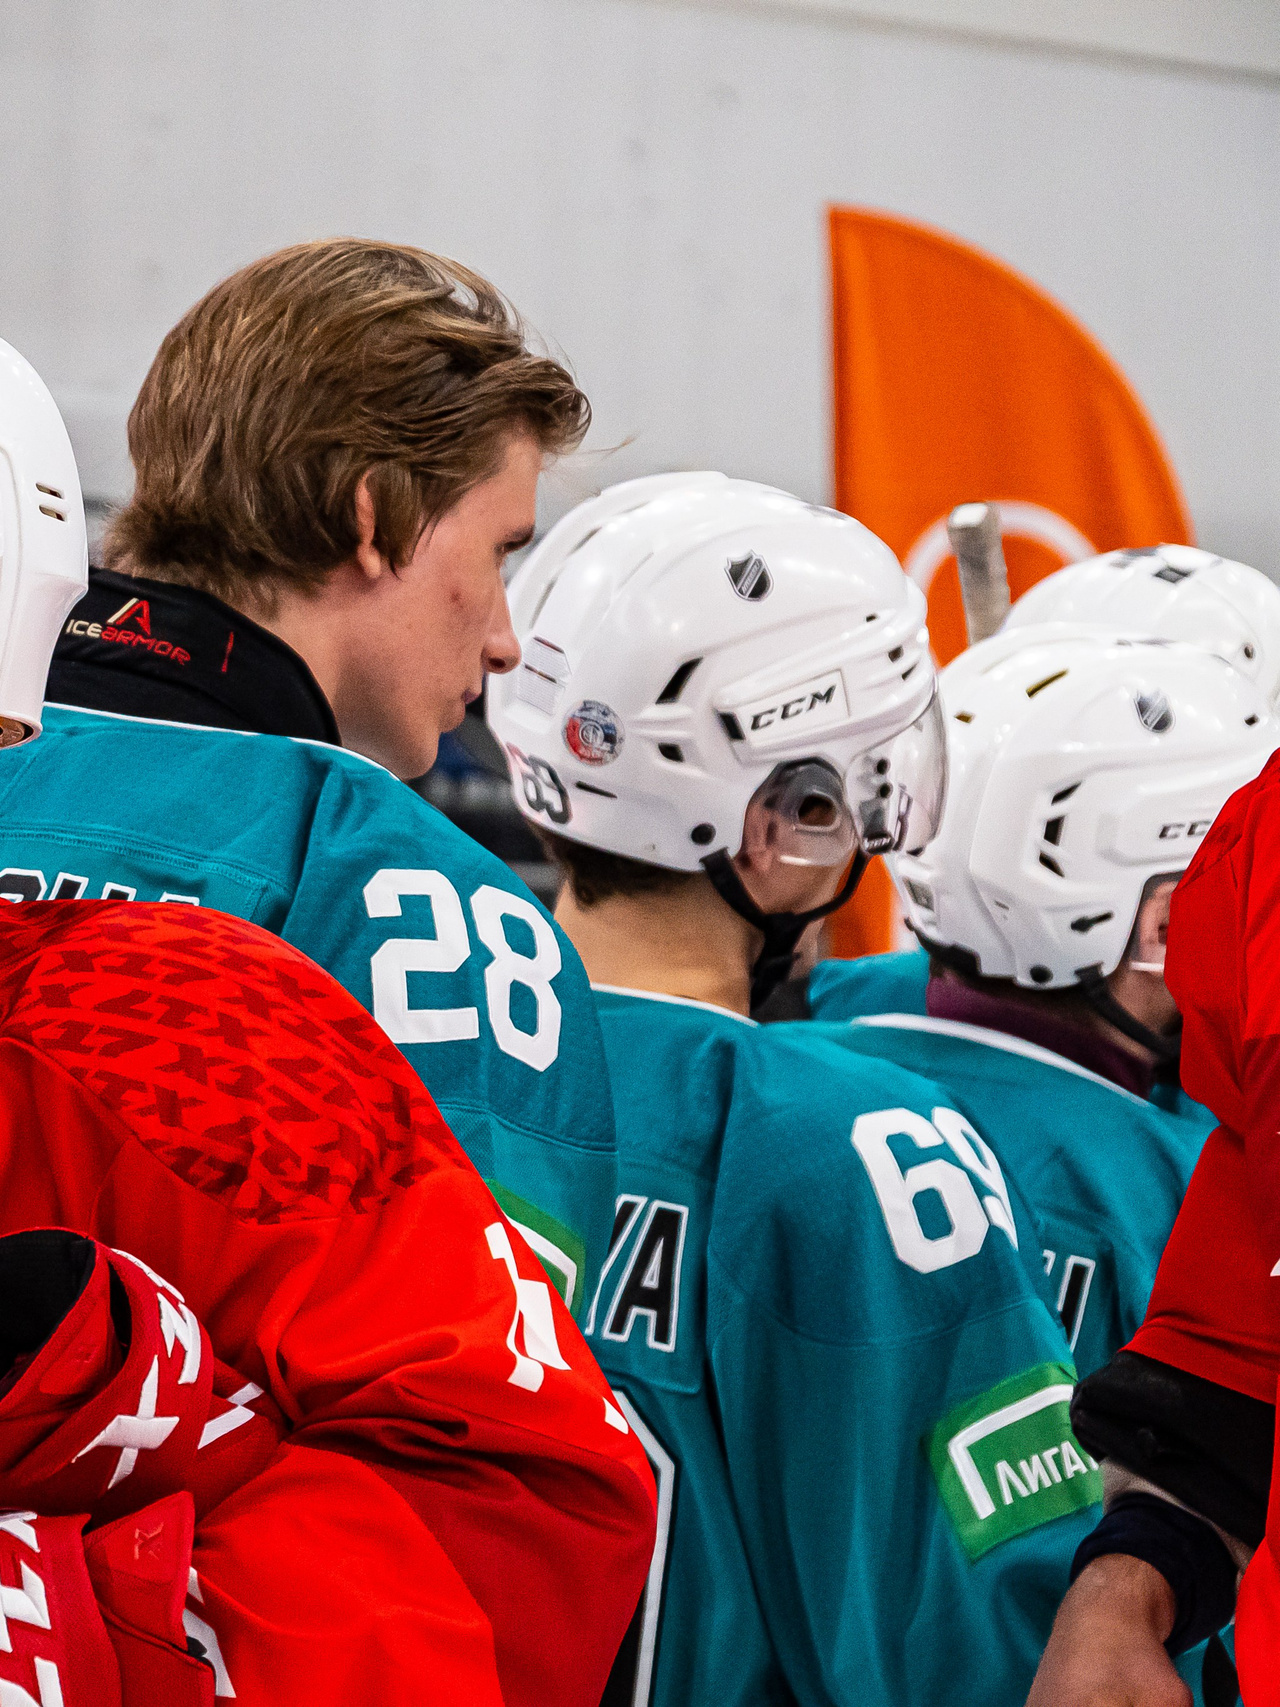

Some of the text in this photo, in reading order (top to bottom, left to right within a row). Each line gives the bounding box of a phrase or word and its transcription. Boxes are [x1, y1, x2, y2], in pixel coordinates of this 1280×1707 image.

[749, 684, 837, 732] CCM
[1158, 818, 1213, 840] CC
[361, 868, 562, 1072] 28
[849, 1105, 1019, 1275] 69
[995, 1440, 1089, 1506] ЛИГА
